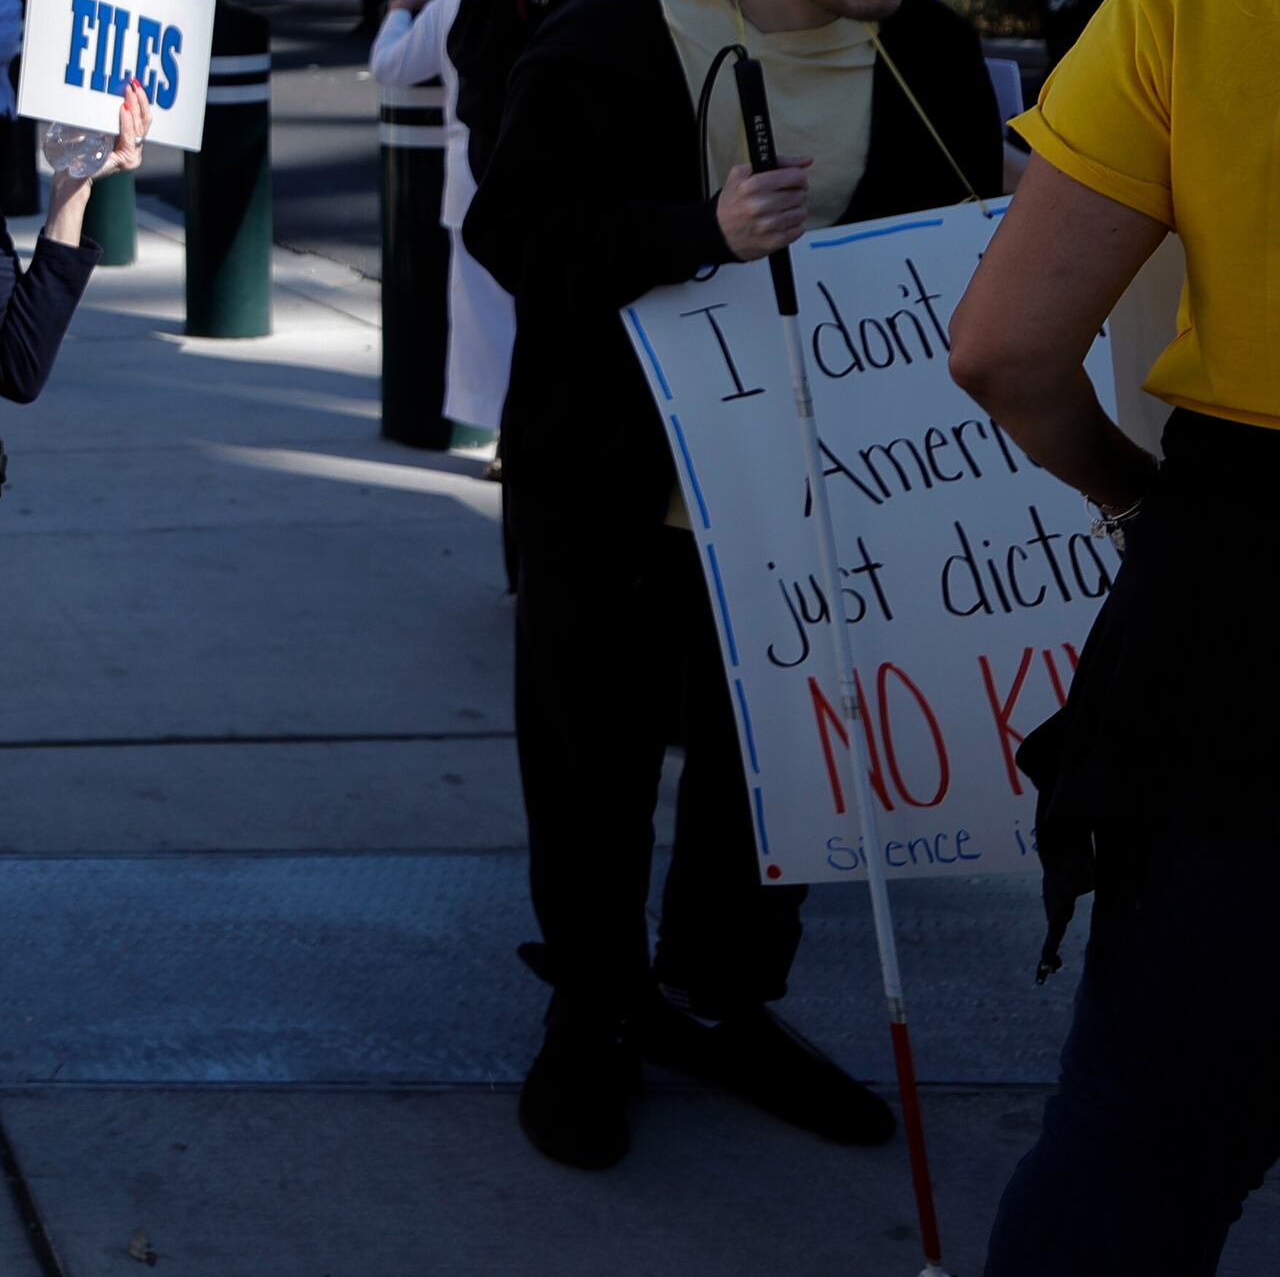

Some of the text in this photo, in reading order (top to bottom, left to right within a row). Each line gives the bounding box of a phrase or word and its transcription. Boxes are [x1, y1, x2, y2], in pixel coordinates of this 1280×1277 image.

[680, 257, 951, 402] I don't
[803, 418, 1045, 518] Ameri
[766, 505, 1124, 668] just dicta
[807, 661, 950, 815] NO
[825, 823, 982, 871] Sience
